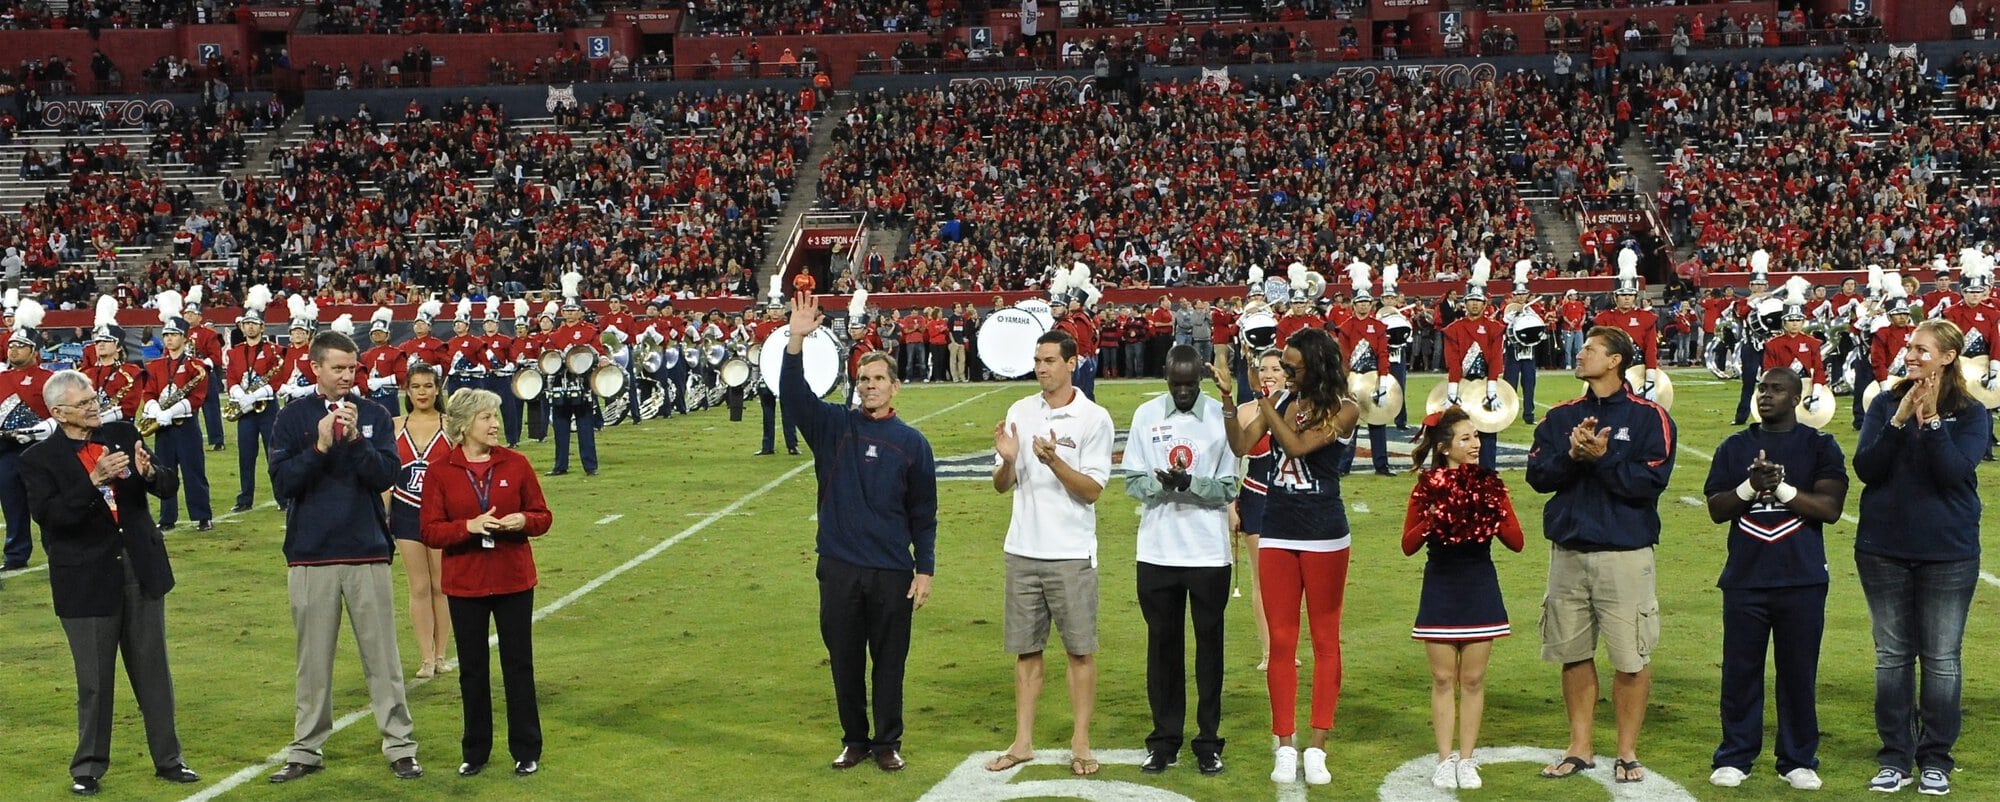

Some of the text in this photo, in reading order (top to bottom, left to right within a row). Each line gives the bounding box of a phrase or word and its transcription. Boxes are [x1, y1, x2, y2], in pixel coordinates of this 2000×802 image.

[1445, 13, 1454, 26] 4
[975, 29, 986, 42] 4
[594, 38, 604, 51] 3
[1598, 214, 1627, 224] SECTION
[1628, 214, 1633, 223] 5
[814, 236, 820, 245] 3
[821, 236, 848, 245] SECTION
[1005, 316, 1030, 325] YAMAHA
